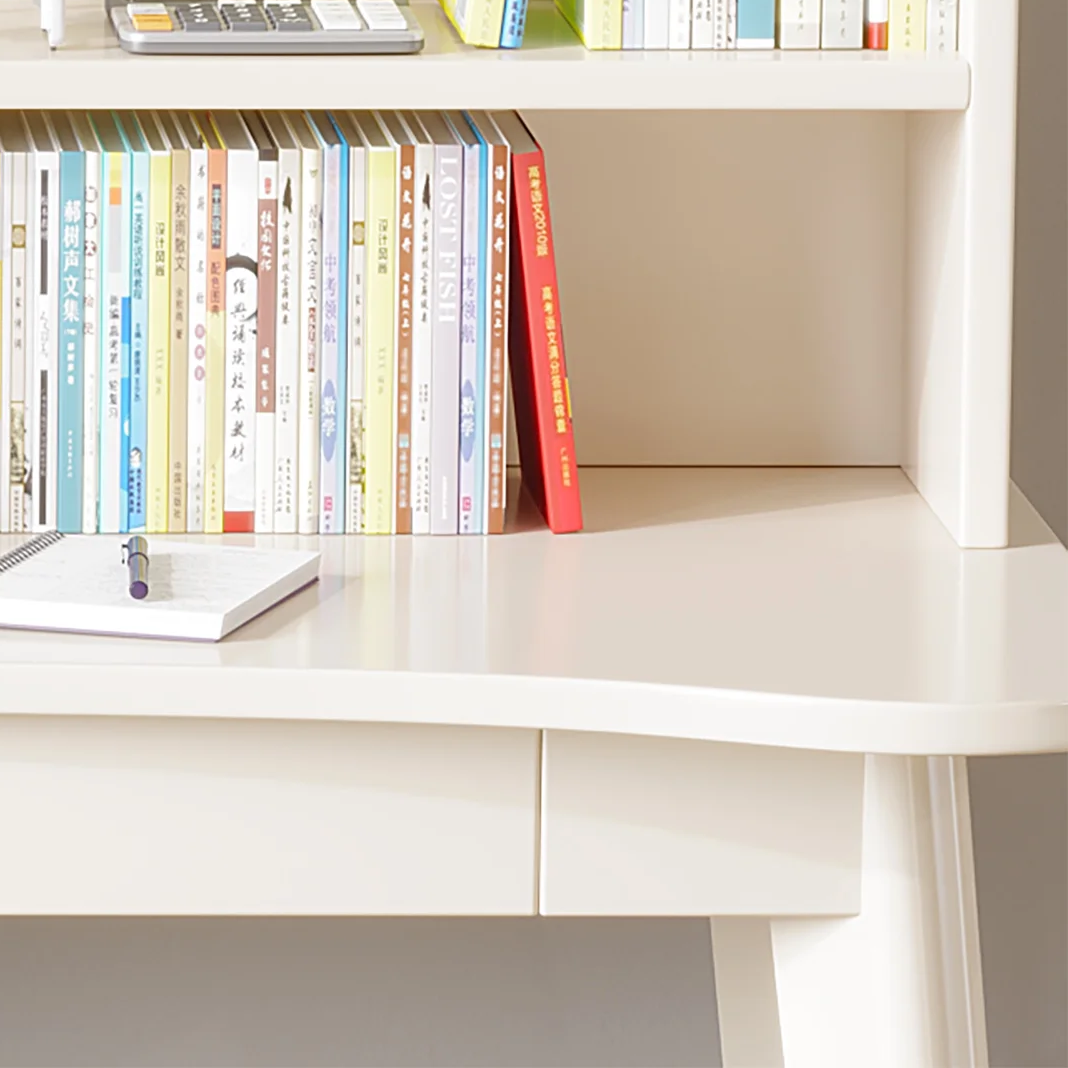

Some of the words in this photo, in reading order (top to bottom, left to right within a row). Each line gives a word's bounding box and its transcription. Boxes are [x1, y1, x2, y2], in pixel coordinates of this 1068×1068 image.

[439, 157, 458, 242] LOST
[63, 199, 81, 323] 郝树声文集
[323, 253, 337, 343] 中考领航
[438, 251, 457, 322] FISH
[322, 396, 336, 437] 数学
